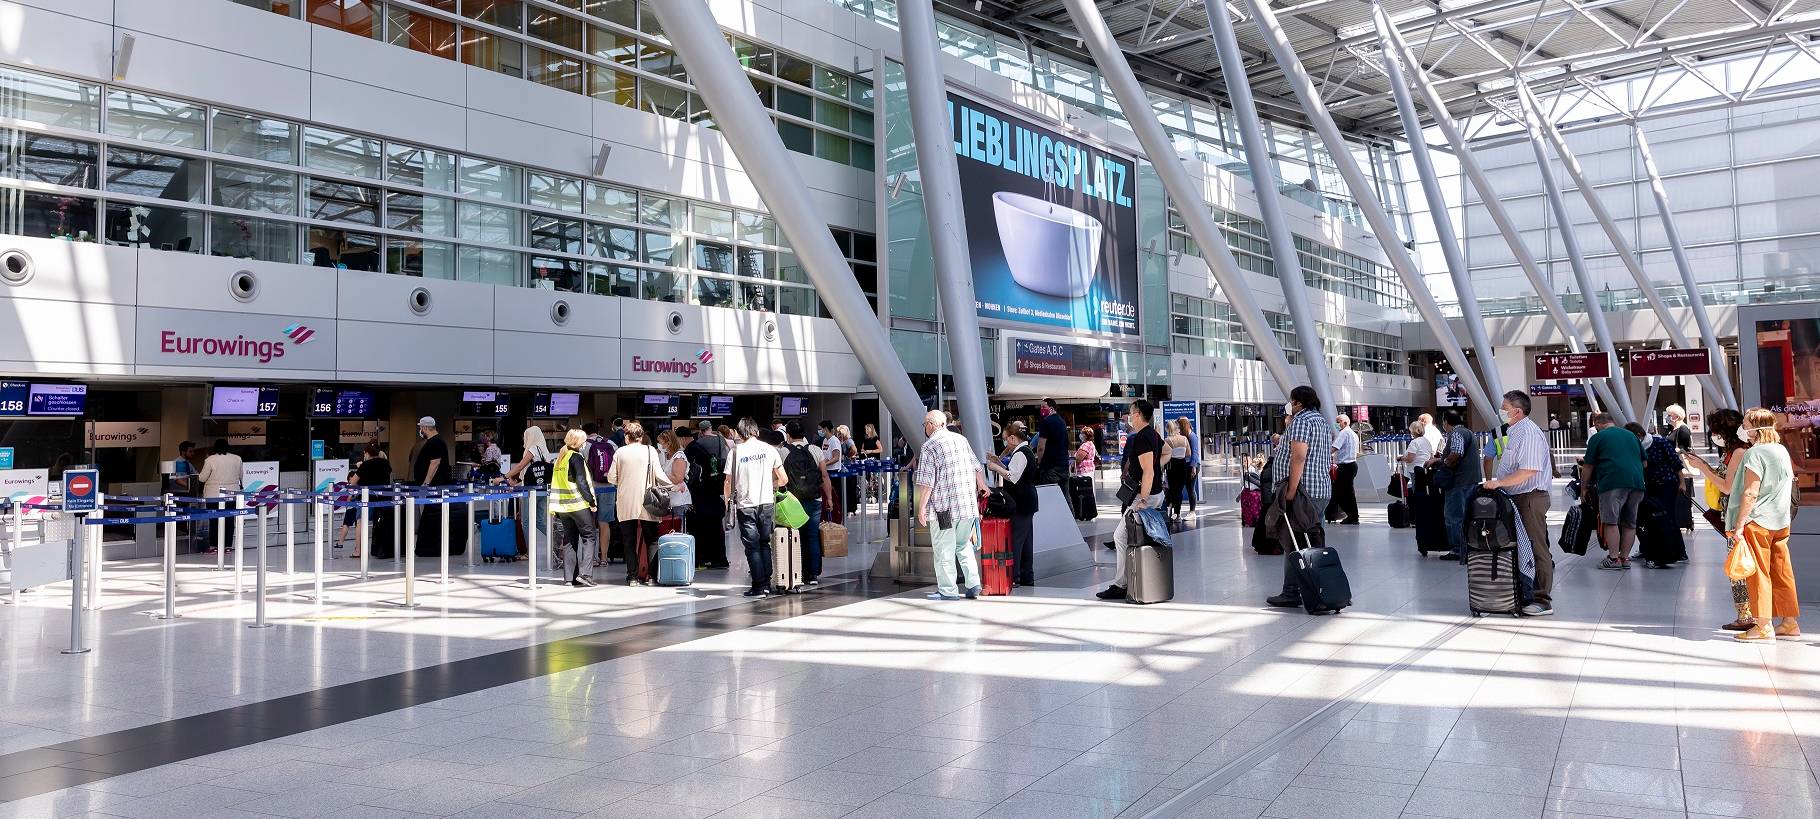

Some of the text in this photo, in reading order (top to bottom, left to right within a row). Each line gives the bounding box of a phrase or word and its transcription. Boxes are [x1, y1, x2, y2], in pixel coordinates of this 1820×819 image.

[947, 100, 1132, 208] LIEBLINGSPLATZ.
[1101, 300, 1135, 317] reuter.de
[161, 330, 285, 363] Eurowings
[1029, 342, 1046, 354] Gates
[633, 356, 698, 378] Eurowings
[1030, 360, 1041, 370] Shops
[1045, 362, 1066, 370] Restaurants
[1, 400, 23, 411] 158
[259, 403, 277, 412] 157
[314, 403, 332, 412] 156
[495, 404, 508, 413] 155
[535, 405, 547, 413] 154
[89, 432, 137, 443] Eurowings
